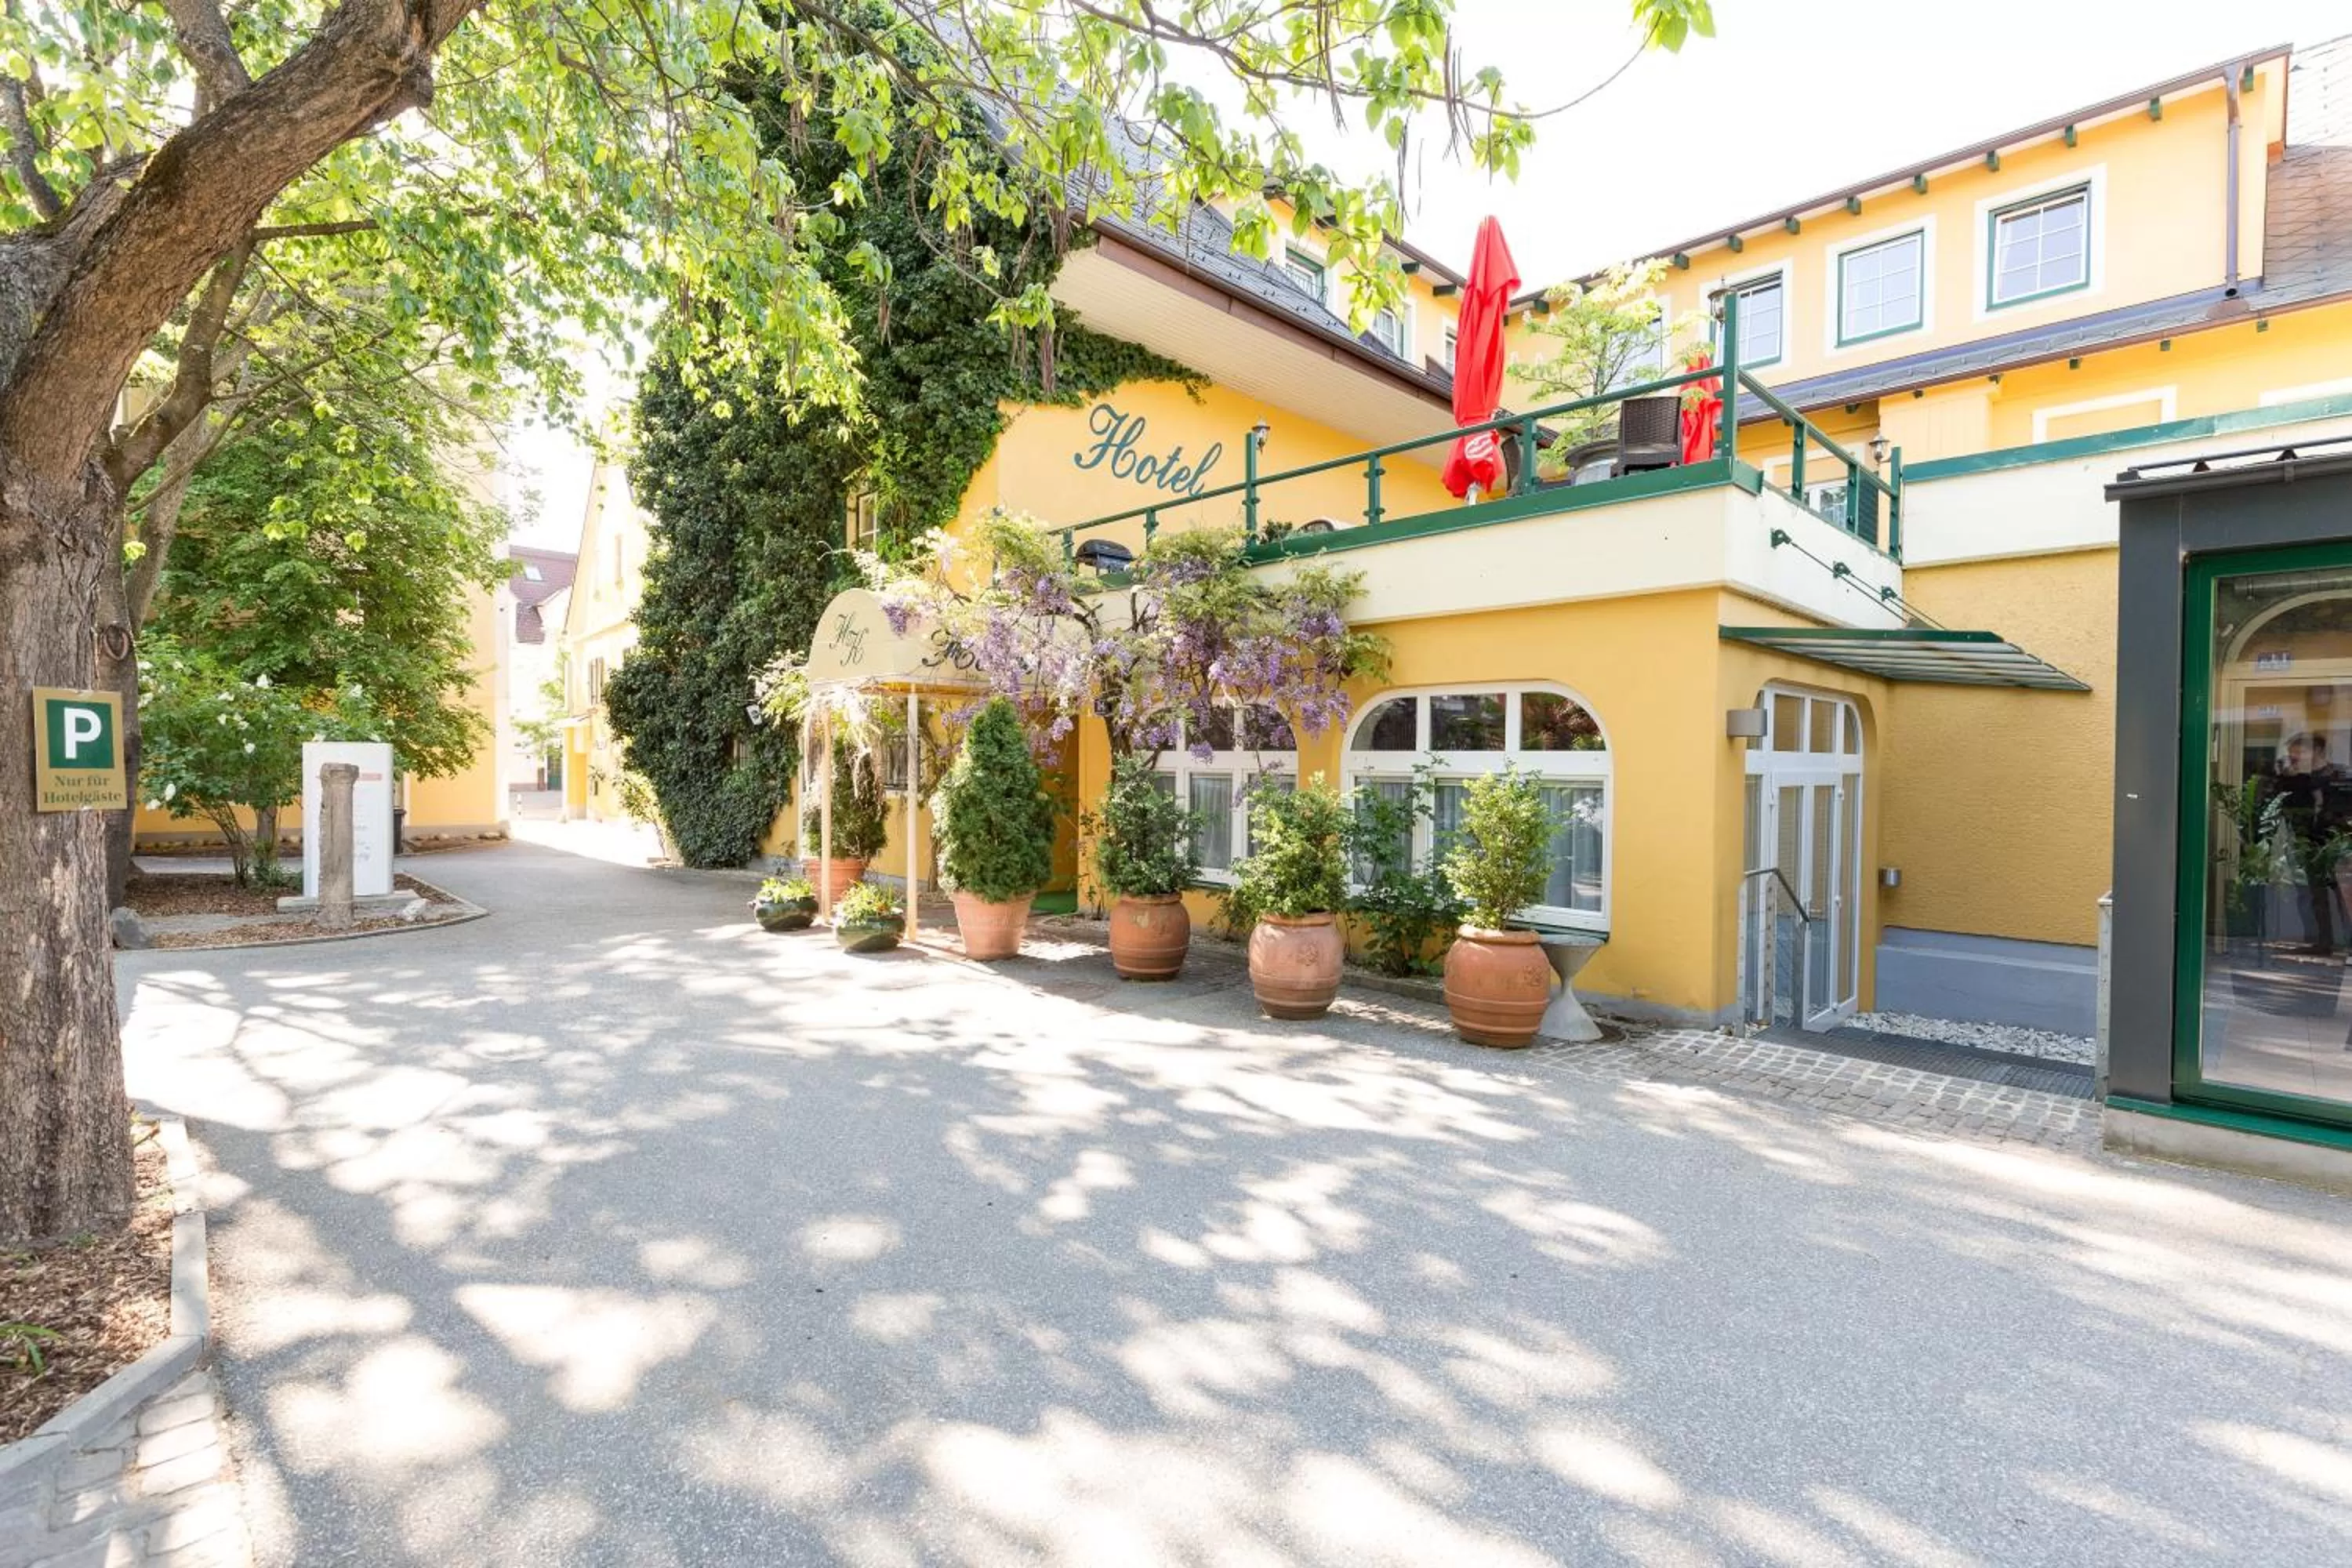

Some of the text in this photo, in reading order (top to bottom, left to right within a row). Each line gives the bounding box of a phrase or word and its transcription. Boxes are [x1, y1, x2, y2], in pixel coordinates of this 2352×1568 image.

[1074, 403, 1222, 497] Hotel
[64, 707, 102, 760] P
[43, 788, 122, 804] Hotelgäste
[55, 774, 111, 787] Nur für
